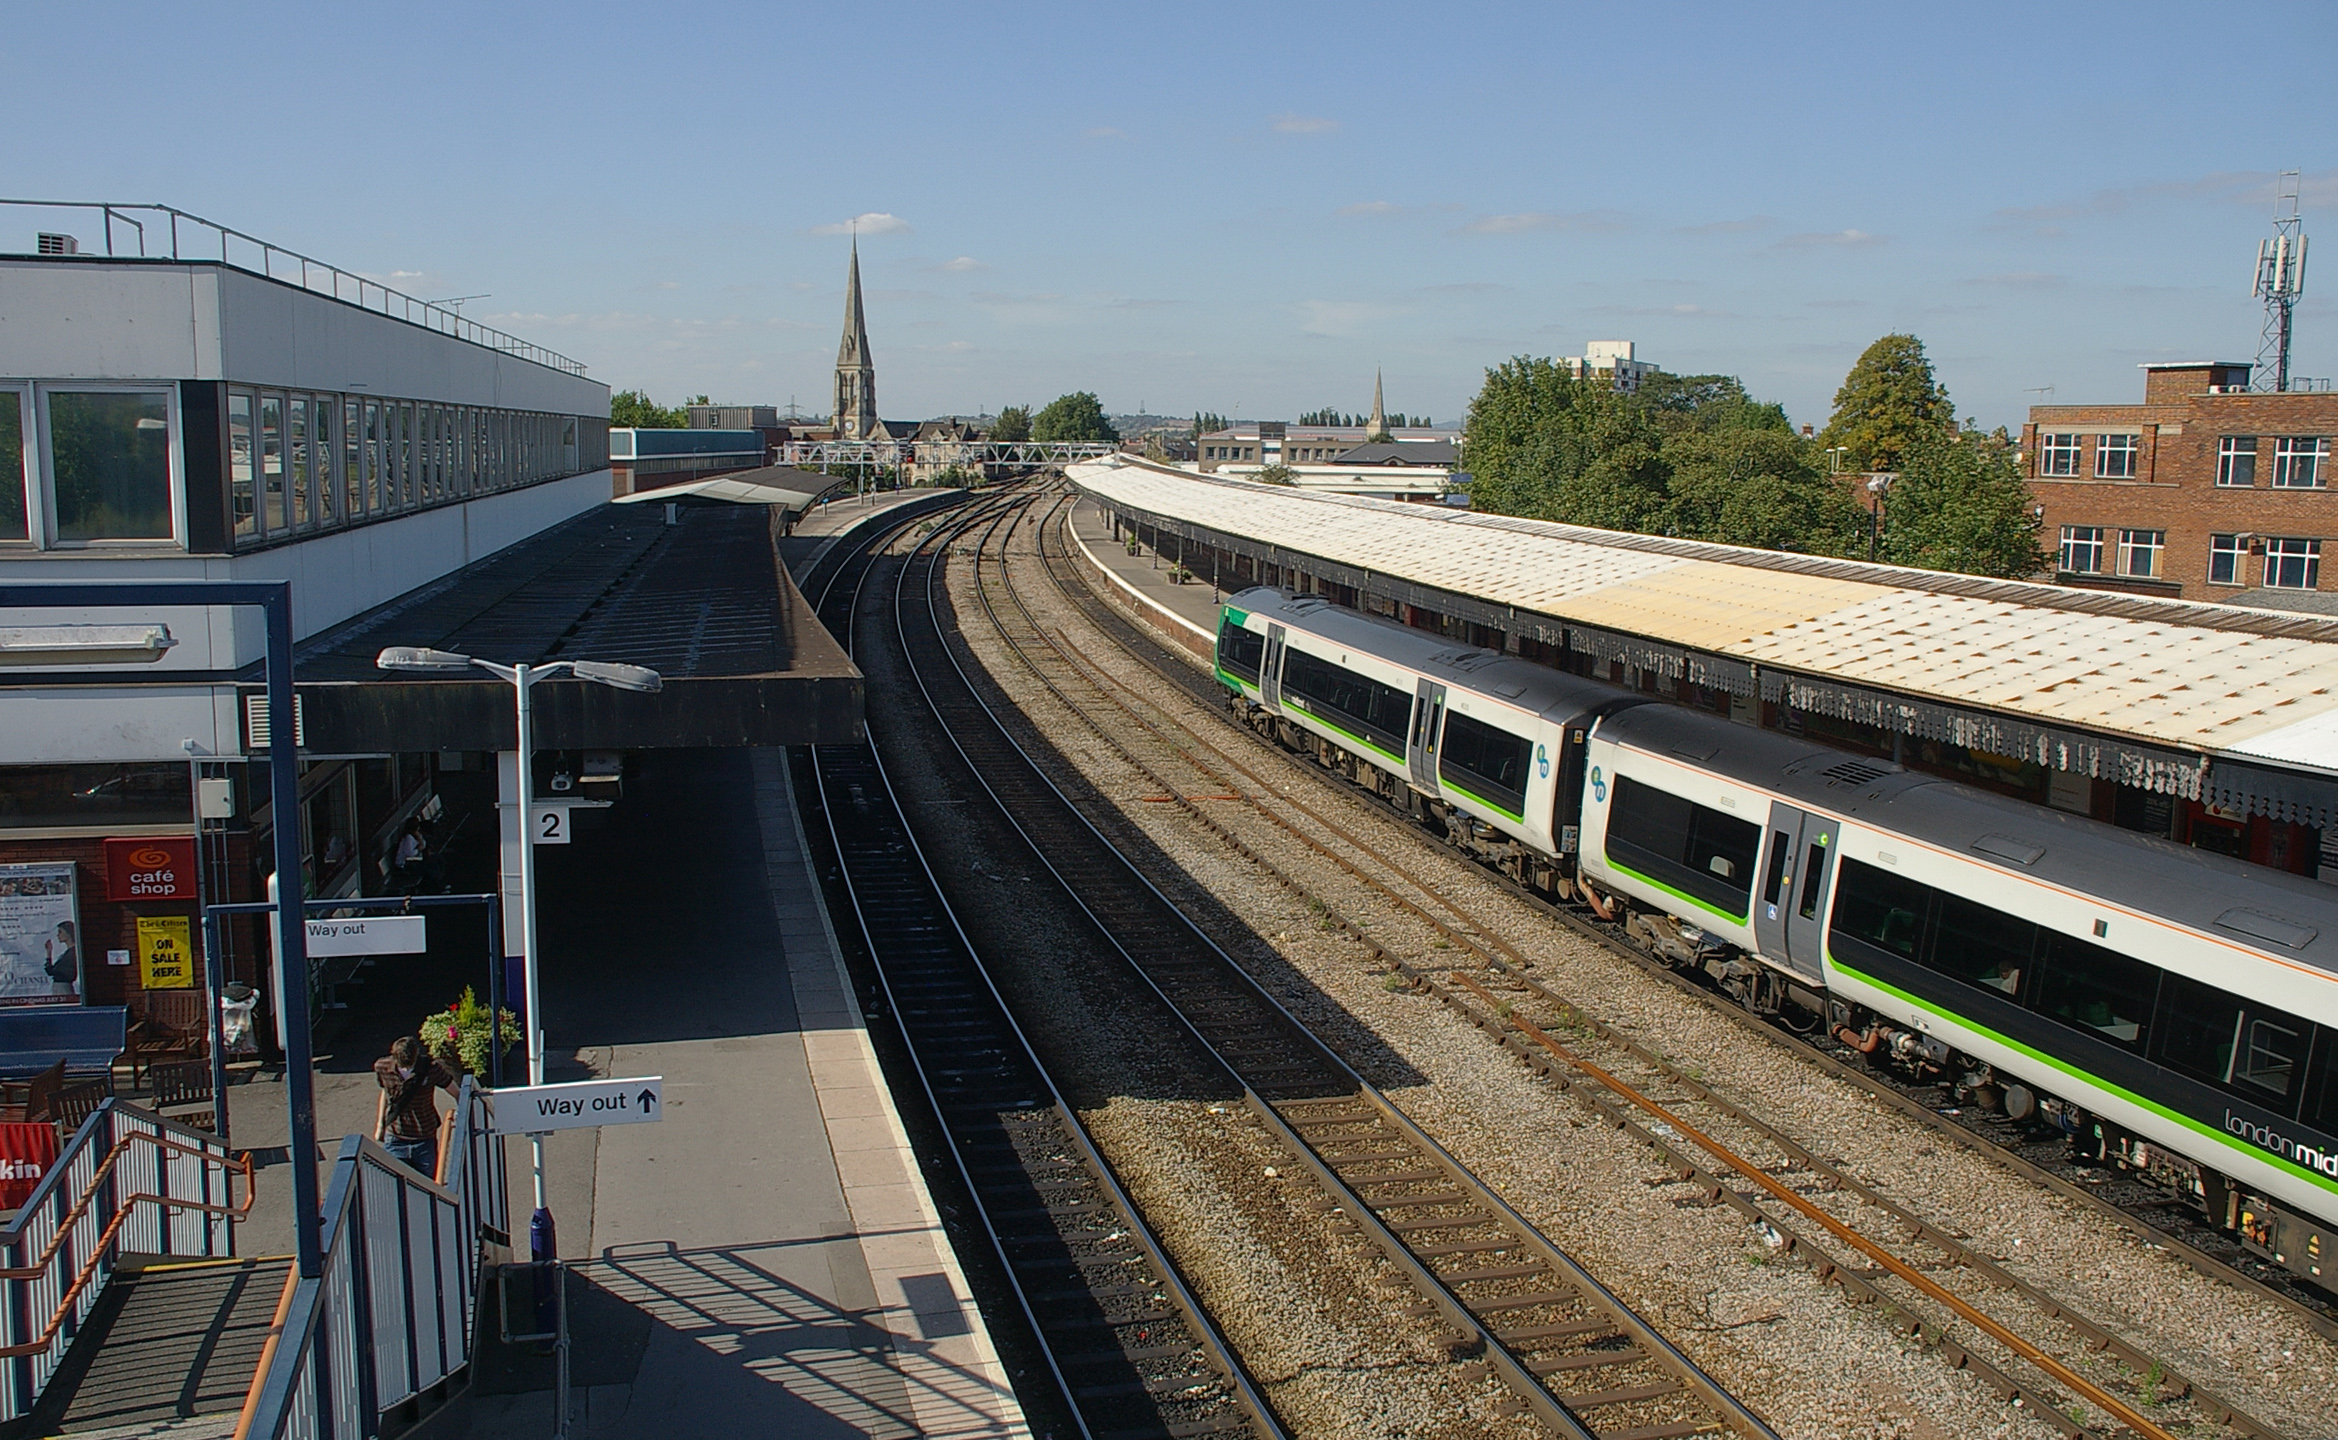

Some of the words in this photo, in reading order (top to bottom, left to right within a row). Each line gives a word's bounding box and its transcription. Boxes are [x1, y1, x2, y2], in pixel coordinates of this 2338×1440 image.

[542, 813, 560, 837] 2
[130, 870, 174, 883] café
[130, 883, 176, 895] shop
[308, 925, 338, 937] Way
[343, 923, 365, 935] out
[156, 939, 173, 949] ON
[152, 953, 180, 963] SALE
[152, 966, 182, 977] HERE
[537, 1098, 584, 1116] Way
[592, 1092, 627, 1111] out
